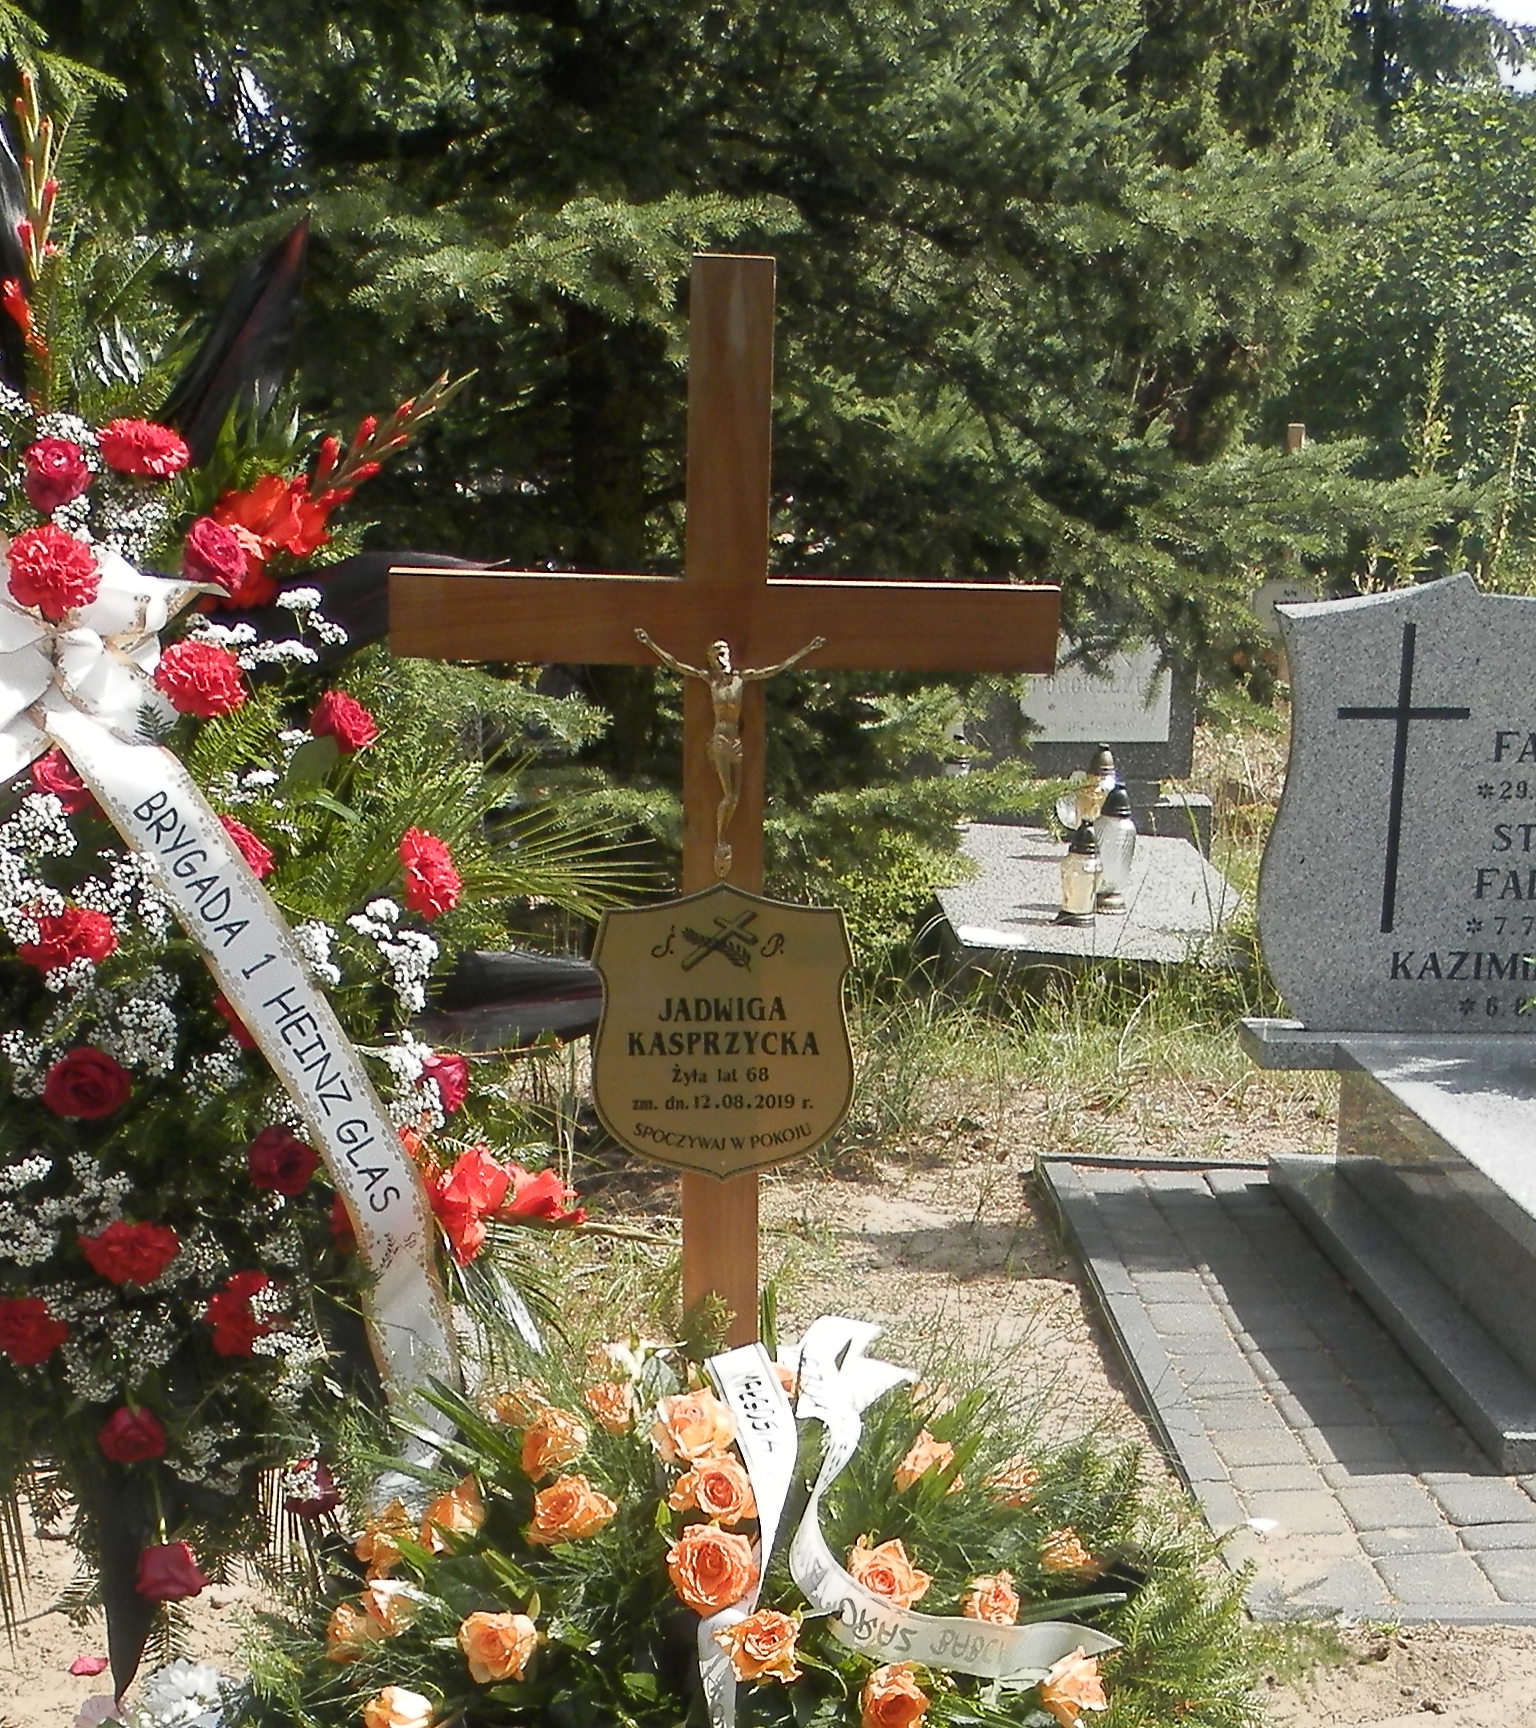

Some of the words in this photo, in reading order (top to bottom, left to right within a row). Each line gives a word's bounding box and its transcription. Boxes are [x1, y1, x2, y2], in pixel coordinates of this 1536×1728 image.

[133, 790, 252, 949] BRYGADA
[241, 953, 274, 980] 1
[261, 986, 354, 1117] HEINZ
[335, 1115, 402, 1213] GLAS
[658, 996, 787, 1023] JADWIGA
[627, 1031, 821, 1057] KASPRZYCKA
[672, 1064, 708, 1087] Żyła
[717, 1069, 738, 1083] lat
[746, 1067, 770, 1082] 68
[632, 1098, 659, 1111] zm.
[633, 1122, 726, 1151] SPOCZYWAJ
[731, 1137, 747, 1151] W
[750, 1123, 813, 1148] POKOJU
